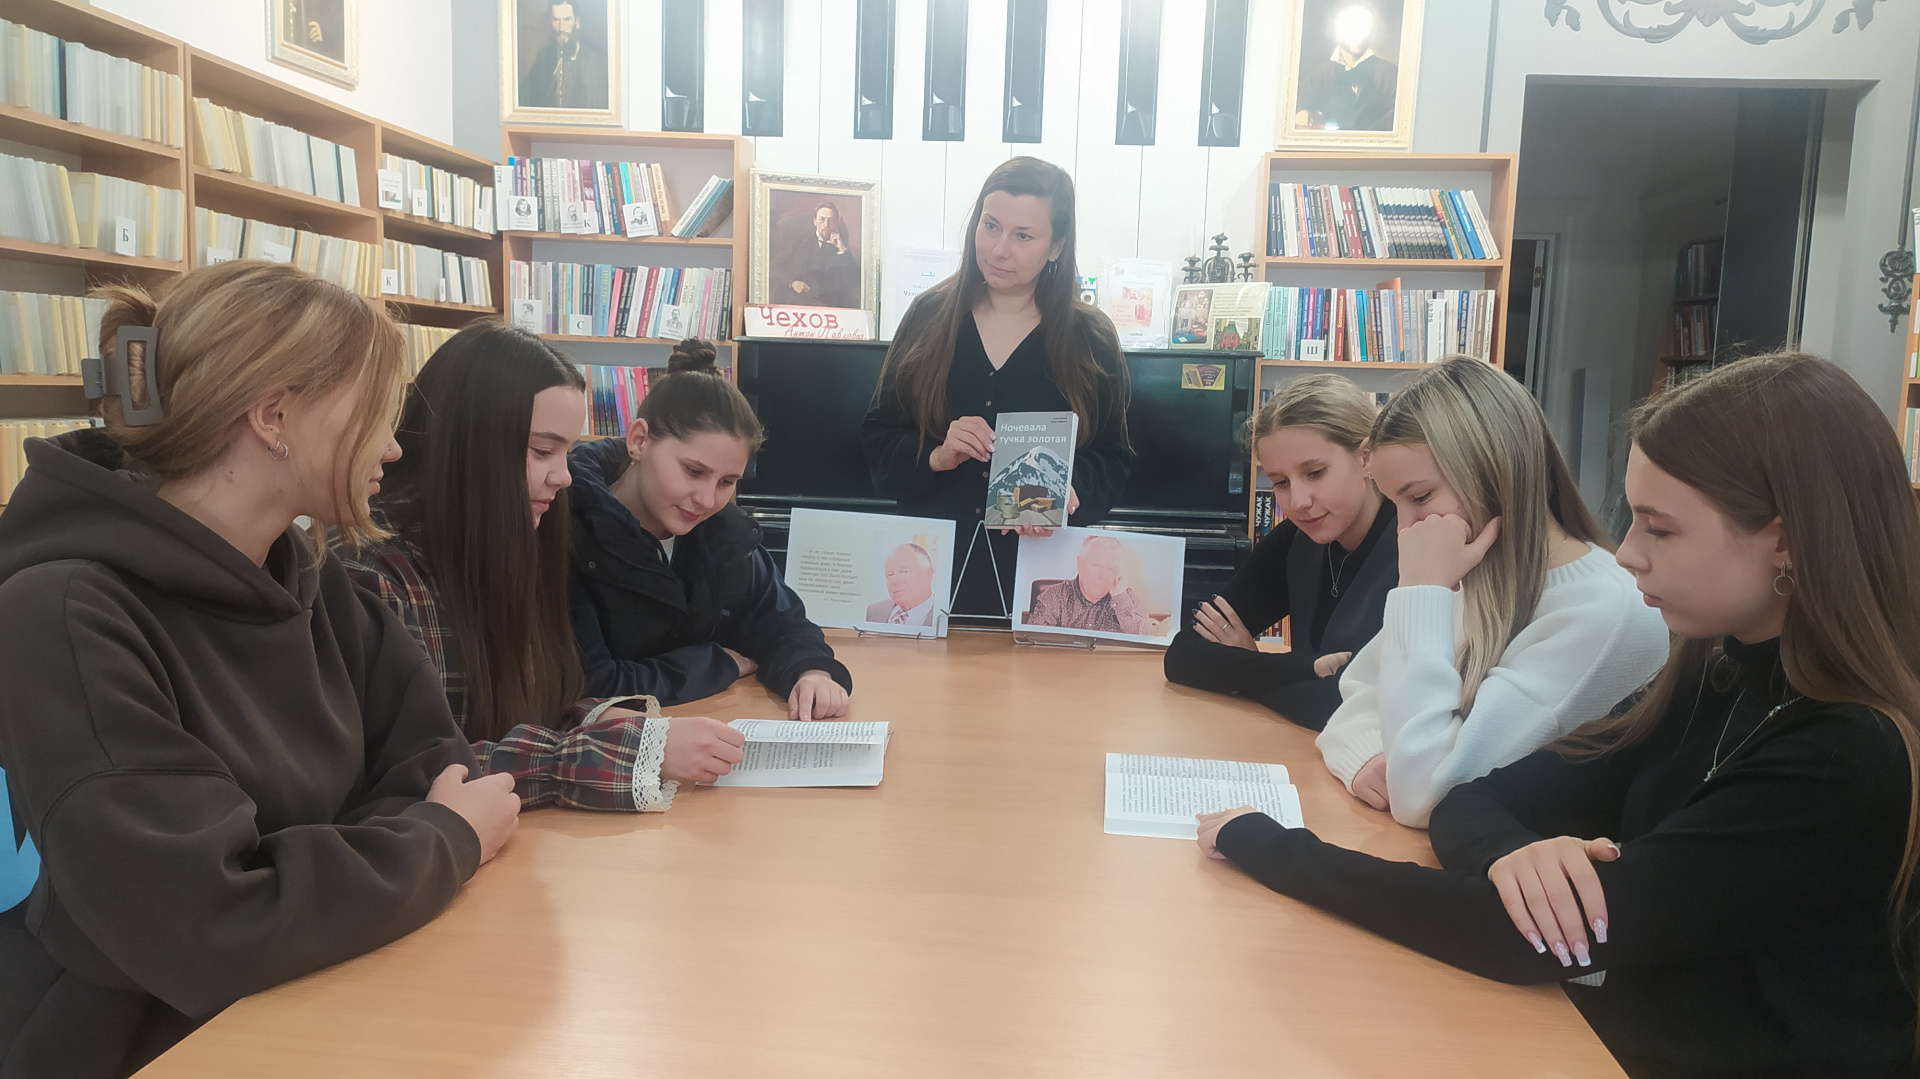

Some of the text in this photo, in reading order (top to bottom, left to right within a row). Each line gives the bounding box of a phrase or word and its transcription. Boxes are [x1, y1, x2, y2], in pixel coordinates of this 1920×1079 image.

[542, 160, 551, 196] ОБЛОМОВ
[584, 218, 592, 228] К
[122, 228, 129, 242] Б
[386, 276, 392, 286] К
[758, 305, 839, 329] Чехов
[576, 320, 585, 330] С
[783, 325, 865, 339] Антон Павлович
[1306, 345, 1319, 355] Ш
[1000, 423, 1047, 432] Ночевала
[998, 435, 1067, 445] тучка золотая
[1255, 495, 1263, 527] ЧУЖАК
[1263, 496, 1272, 528] ЧУЖАК
